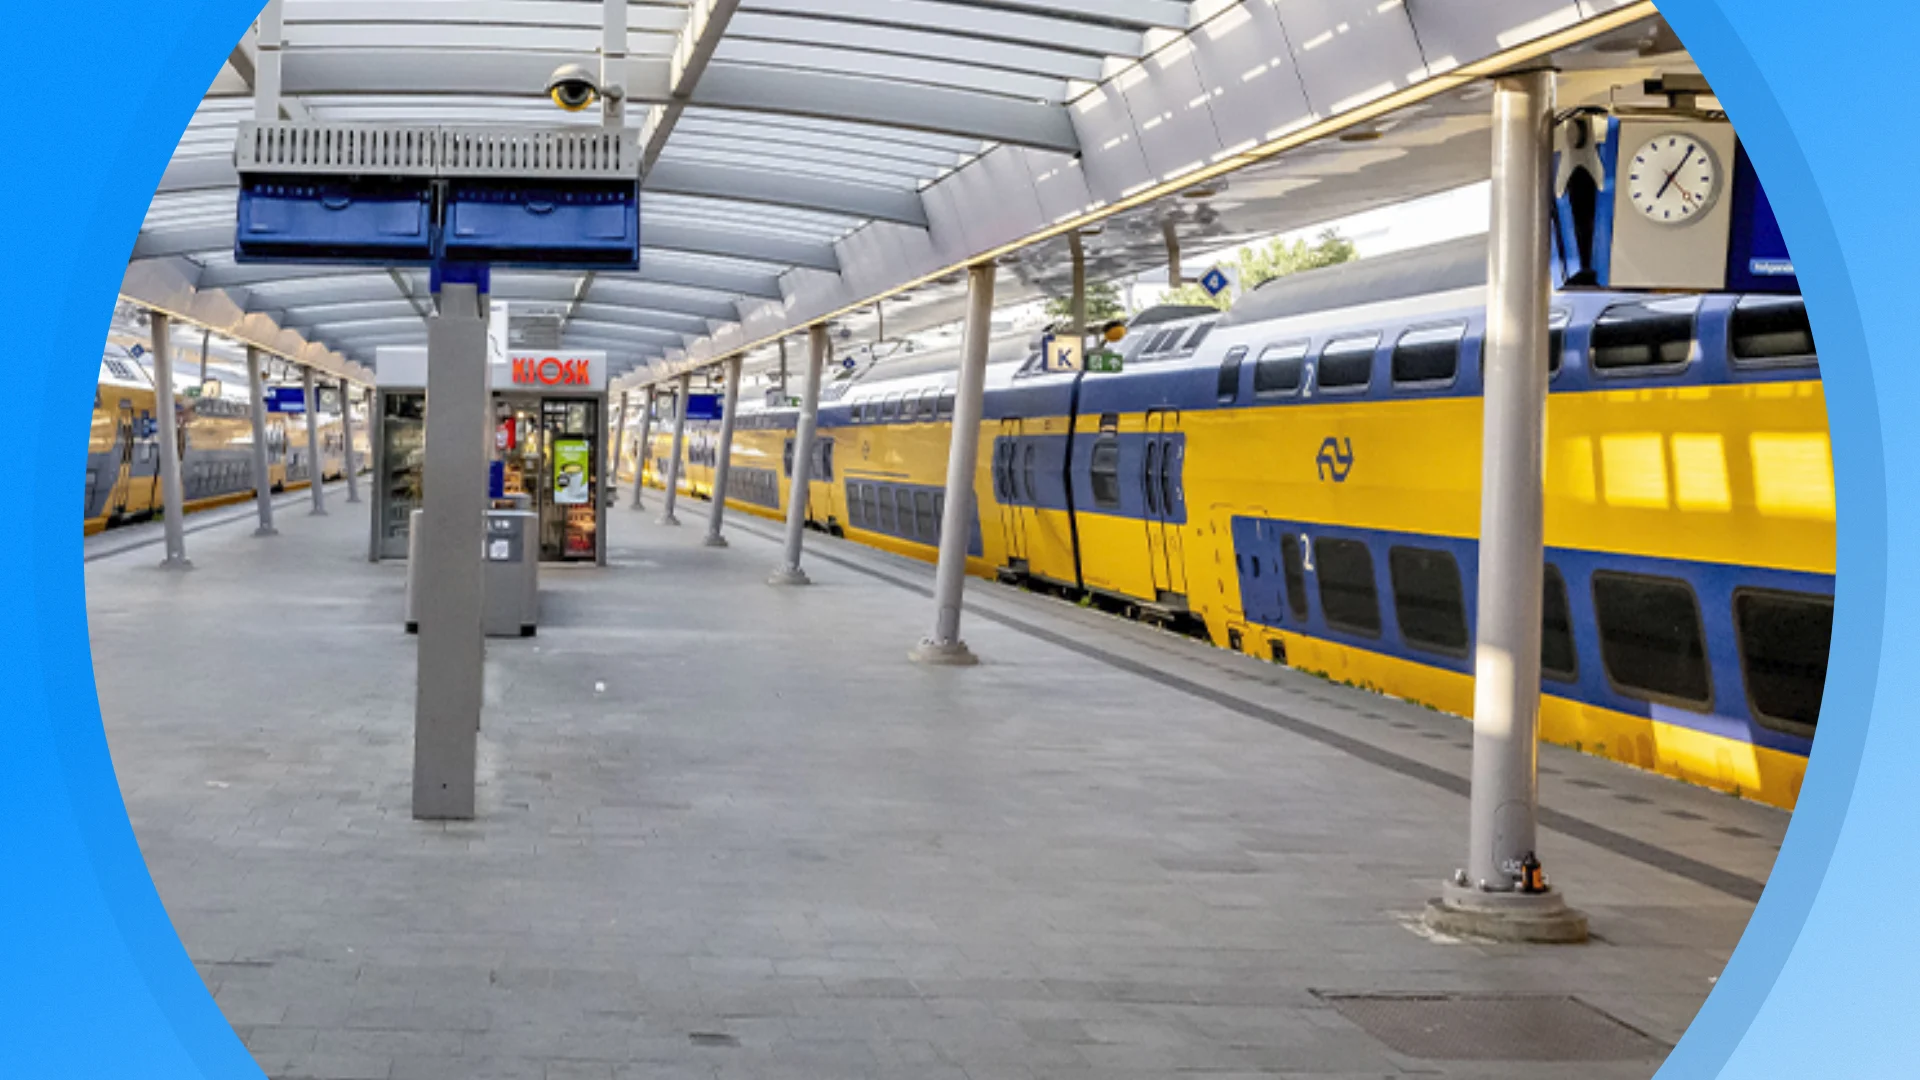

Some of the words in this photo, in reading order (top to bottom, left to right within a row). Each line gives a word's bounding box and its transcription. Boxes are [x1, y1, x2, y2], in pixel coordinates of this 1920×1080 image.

[512, 357, 590, 385] KIOSK
[1057, 348, 1072, 367] K
[1302, 362, 1314, 397] 2
[1300, 532, 1314, 571] 2
